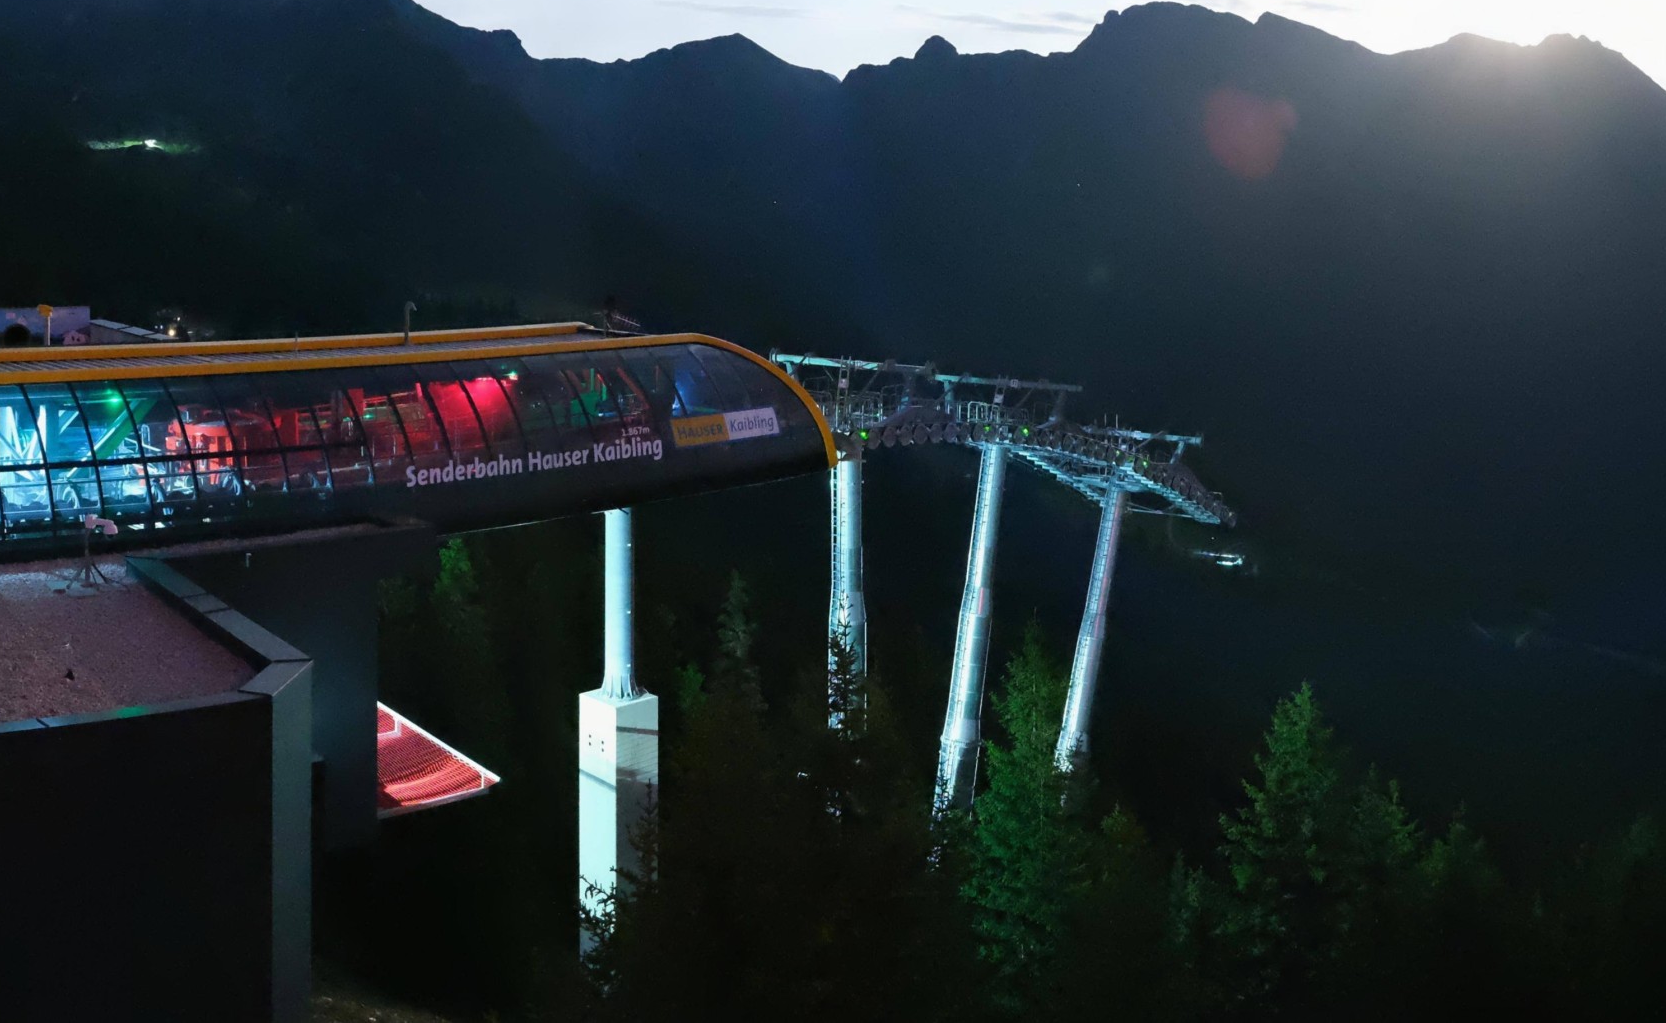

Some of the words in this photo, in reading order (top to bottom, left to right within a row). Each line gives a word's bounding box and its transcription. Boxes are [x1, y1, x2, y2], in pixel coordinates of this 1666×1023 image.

[676, 422, 724, 440] HAUSER
[730, 415, 774, 433] Kaibling
[405, 453, 524, 488] Senderbahn
[528, 447, 590, 472] Hauser
[593, 436, 663, 462] Kaibling
